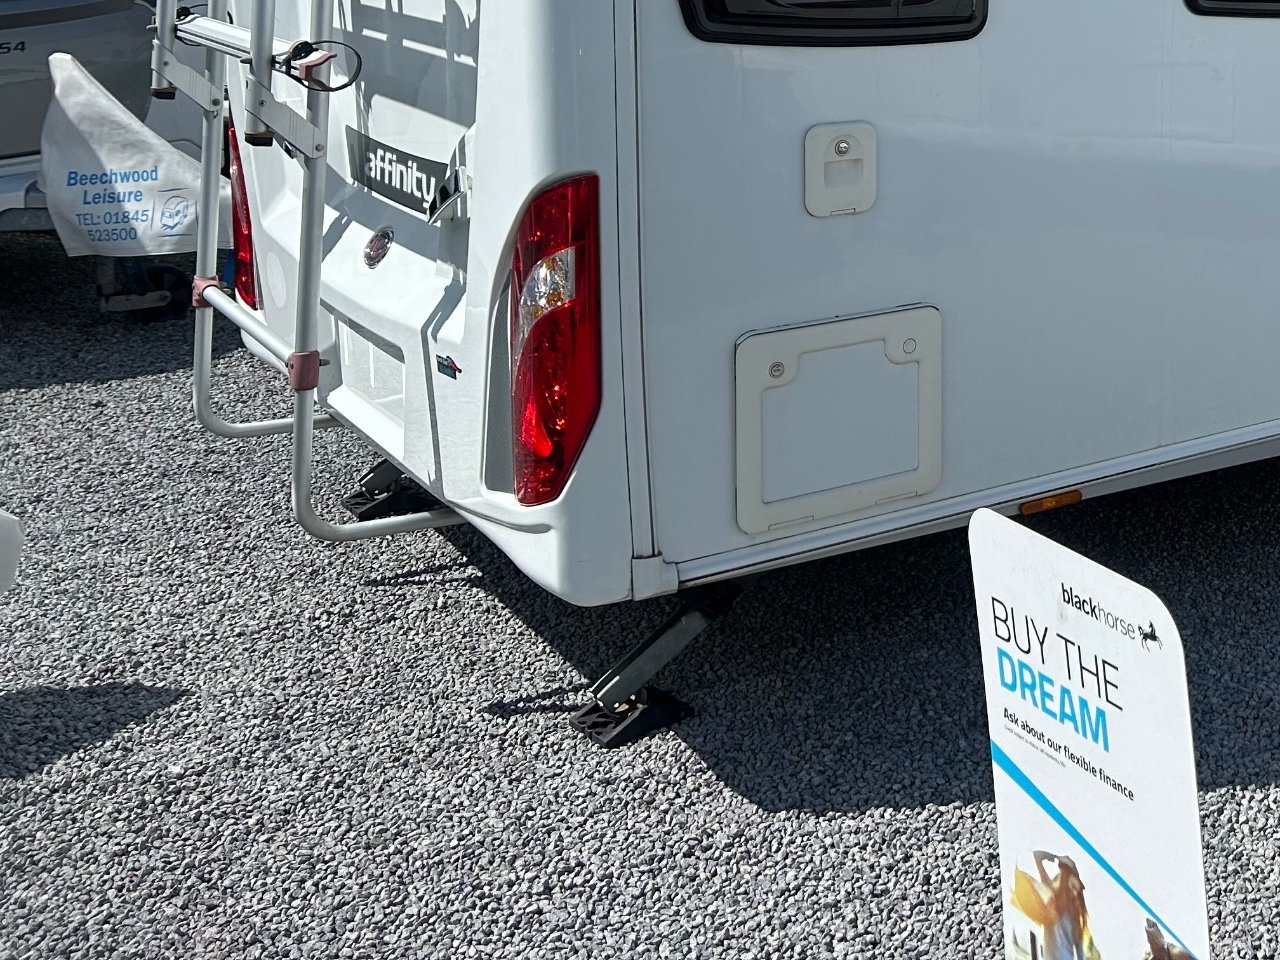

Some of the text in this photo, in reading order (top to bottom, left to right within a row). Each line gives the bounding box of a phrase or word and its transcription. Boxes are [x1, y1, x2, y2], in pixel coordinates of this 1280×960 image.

[66, 165, 158, 187] Beechwood
[82, 187, 143, 205] Leisure
[364, 148, 436, 209] affinity
[87, 227, 138, 242] 523500
[103, 209, 150, 225] 01845
[1061, 582, 1136, 640] blackhorse
[991, 596, 1123, 712] BUY THE
[997, 646, 1110, 753] DREAM
[1003, 707, 1020, 728] Ask
[1020, 720, 1046, 744] about
[1047, 737, 1062, 754] our
[1063, 745, 1097, 778] flexible
[1099, 767, 1135, 801] finance
